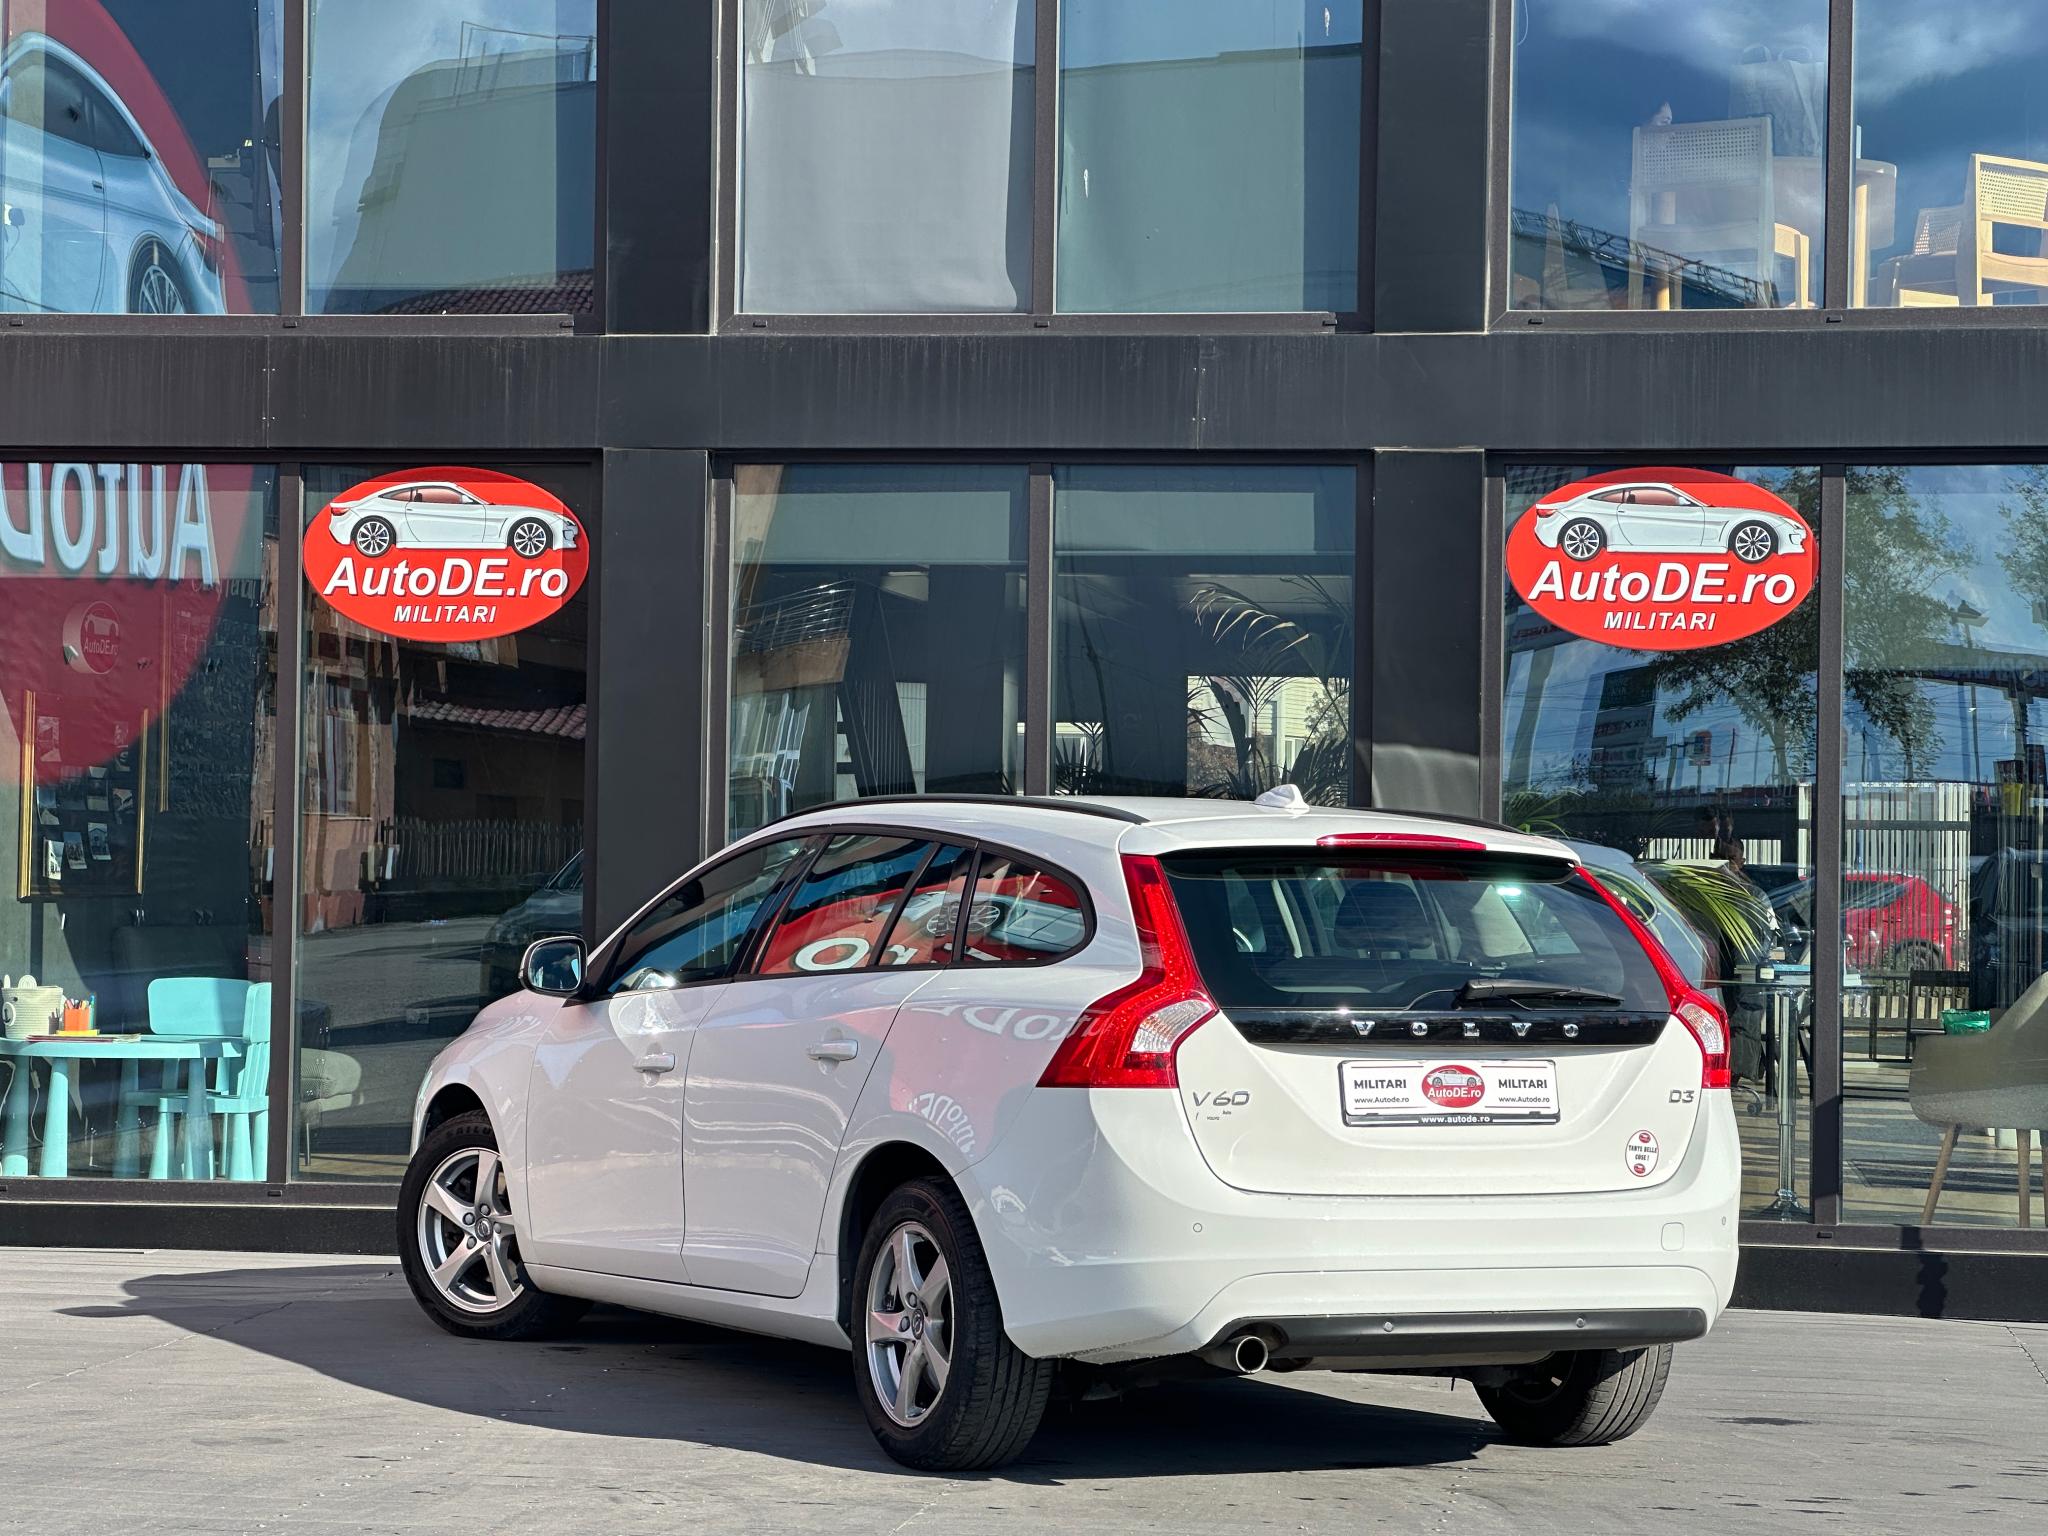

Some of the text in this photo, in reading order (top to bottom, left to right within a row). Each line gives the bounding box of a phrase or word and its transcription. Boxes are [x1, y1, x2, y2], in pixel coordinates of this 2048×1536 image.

[323, 557, 569, 598] AutoDE.ro
[1528, 560, 1797, 604] AutoDE.ro
[393, 605, 497, 623] MILITARI
[1603, 611, 1716, 631] MILITARI
[1352, 1020, 1580, 1039] VOLVO
[1353, 1079, 1408, 1090] MILITARI
[1498, 1078, 1549, 1089] MILITARI
[1192, 1090, 1250, 1107] V60
[1354, 1096, 1410, 1104] www.Autode.ro
[1427, 1086, 1482, 1099] AutoDE.ro
[1498, 1096, 1551, 1104] www.Autode.ro
[1668, 1089, 1695, 1104] D3
[1421, 1114, 1491, 1124] www.autode.ro
